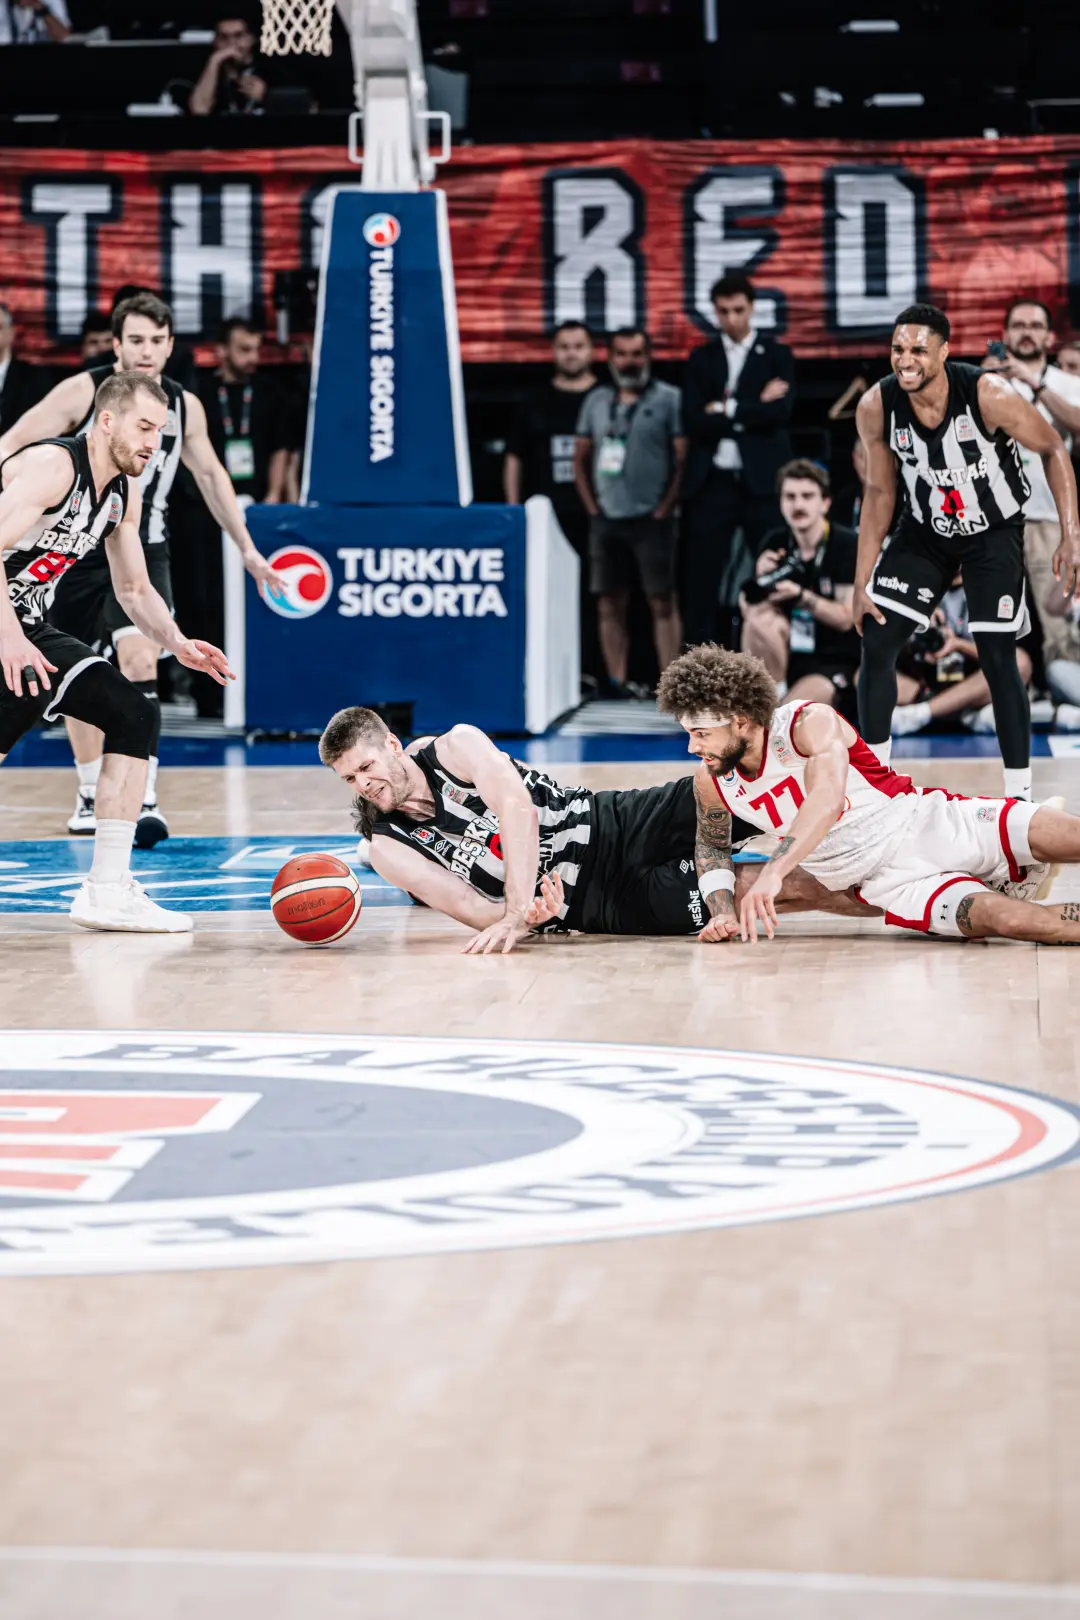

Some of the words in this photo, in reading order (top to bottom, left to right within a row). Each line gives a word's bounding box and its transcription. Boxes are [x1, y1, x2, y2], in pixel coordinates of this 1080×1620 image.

[22, 172, 336, 342] TH
[541, 165, 928, 337] RED
[748, 775, 805, 830] 77
